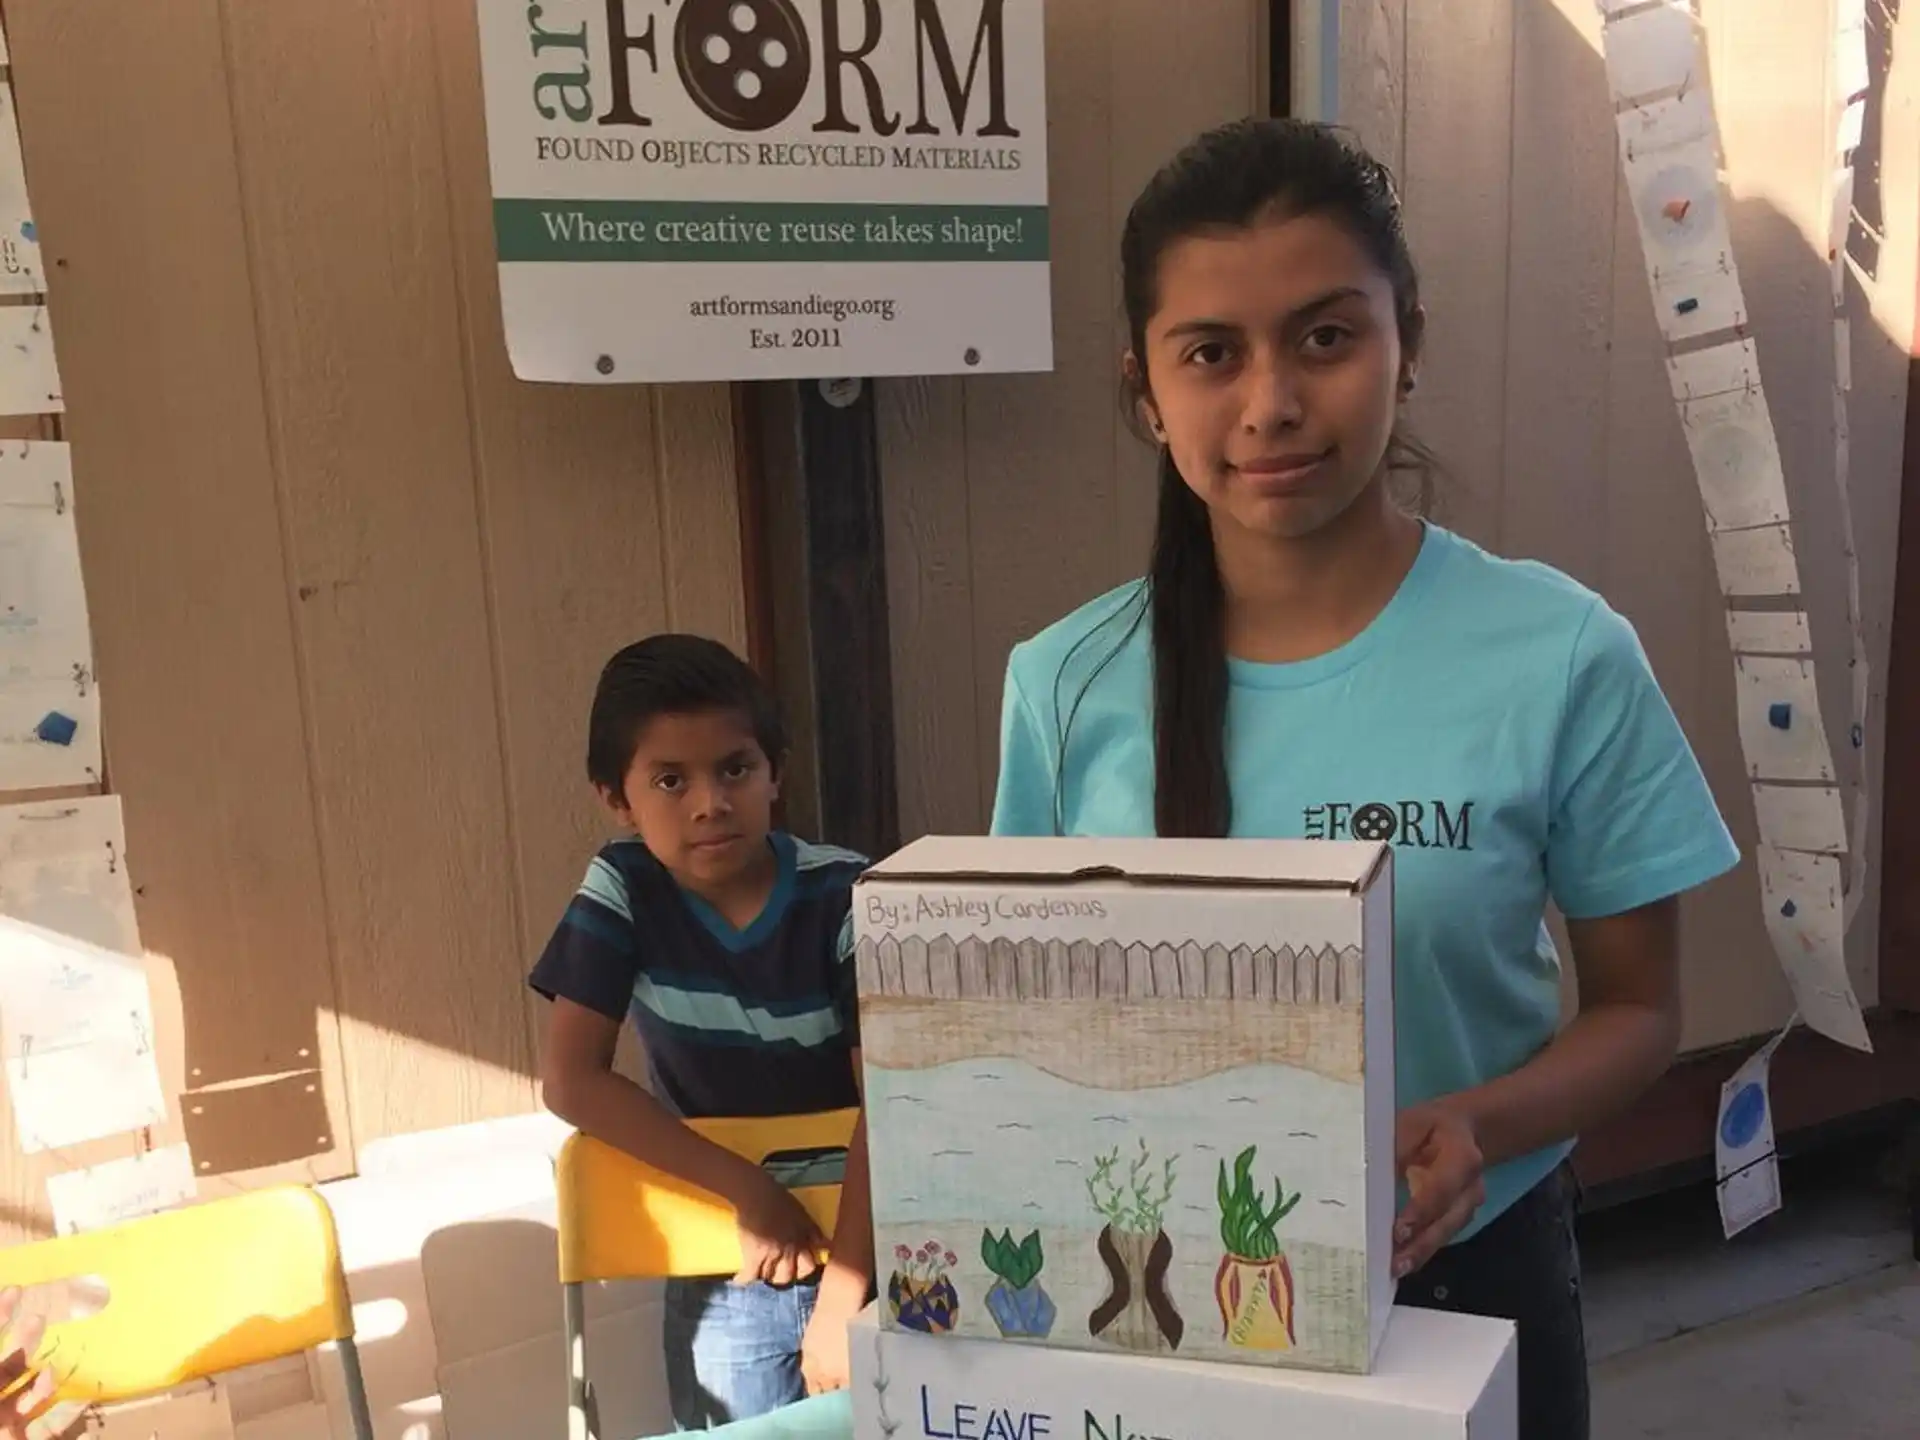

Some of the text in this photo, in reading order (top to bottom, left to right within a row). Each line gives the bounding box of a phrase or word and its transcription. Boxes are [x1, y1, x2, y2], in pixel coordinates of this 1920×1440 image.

[536, 136, 1022, 171] FOUND OBJECTS RECYCLED MATERIALS
[541, 211, 1024, 252] Where creative reuse takes shape!
[690, 294, 896, 321] artformsandiego.org
[750, 328, 843, 349] Est. 2011
[867, 893, 1108, 930] By: Ashley Cardenas
[921, 1384, 1052, 1440] LEAVE
